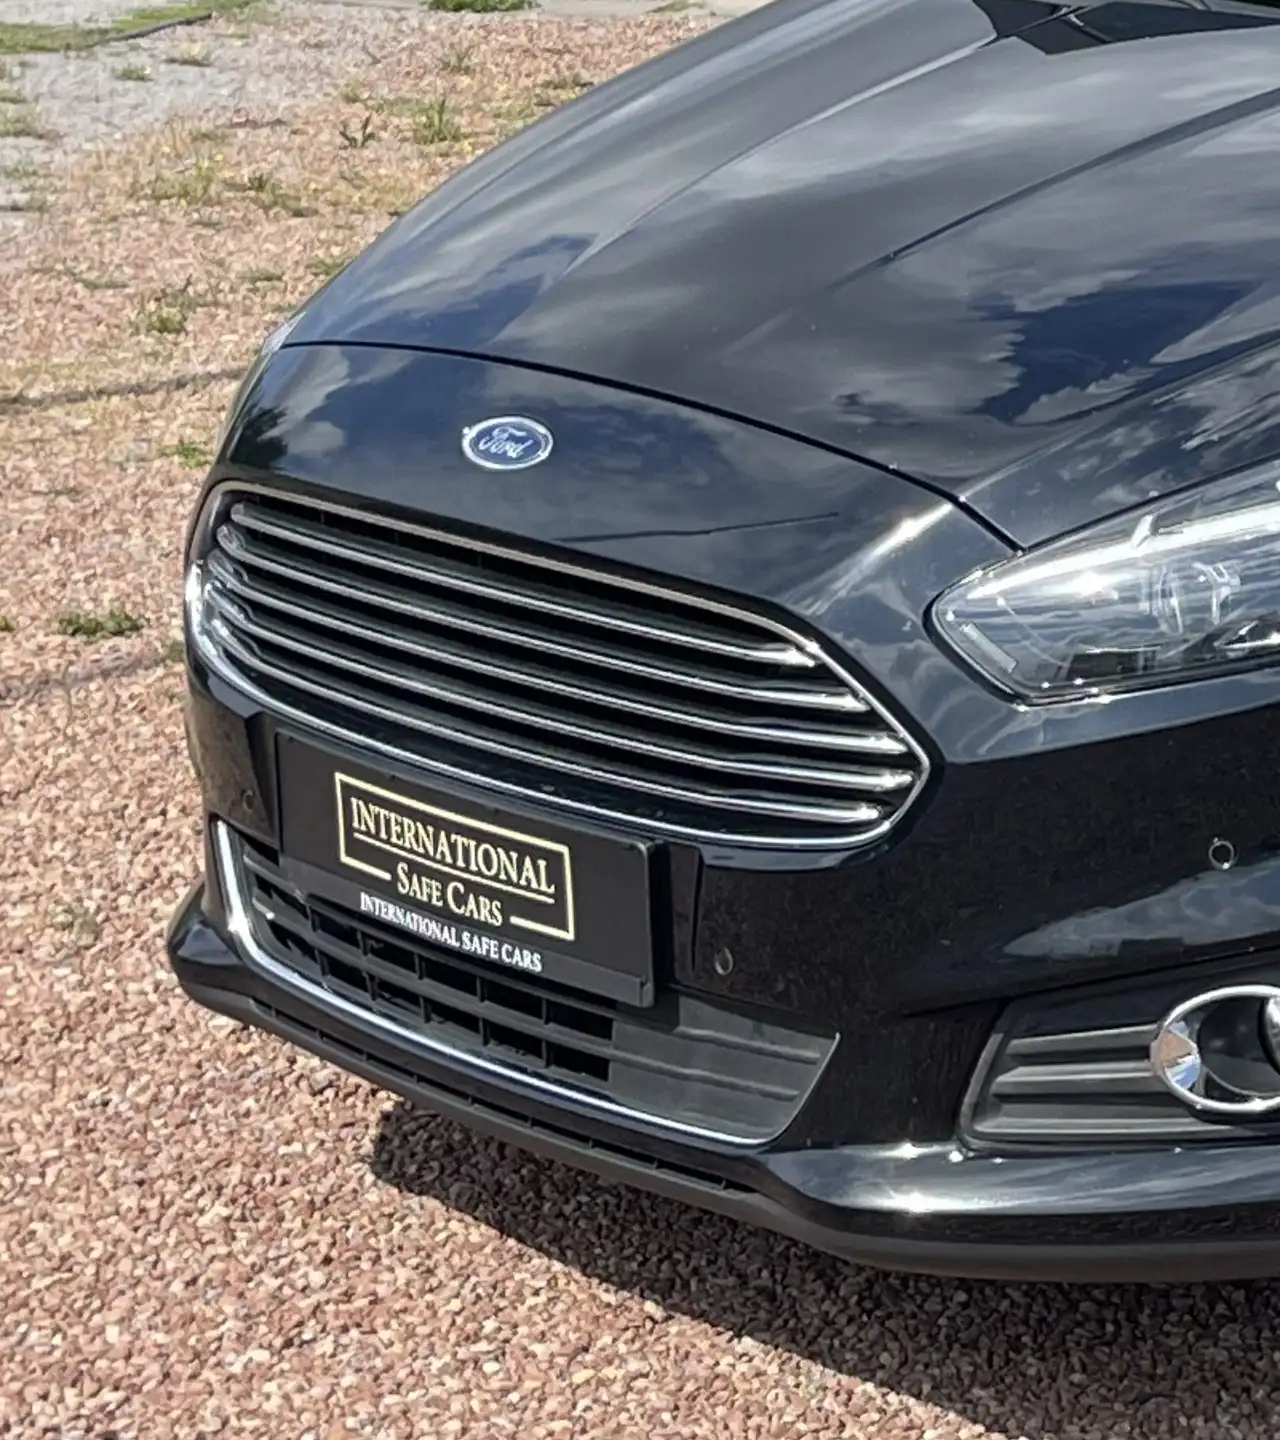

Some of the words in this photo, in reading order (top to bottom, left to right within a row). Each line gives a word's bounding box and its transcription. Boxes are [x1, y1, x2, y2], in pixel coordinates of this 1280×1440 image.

[478, 426, 535, 458] Ford
[350, 796, 556, 893] INTERNATIONAL
[396, 863, 444, 908] SAFE
[446, 882, 503, 927] CARS
[360, 892, 461, 948] INTERNATIONAL
[461, 931, 500, 959] SAFE
[501, 943, 543, 973] CARS
